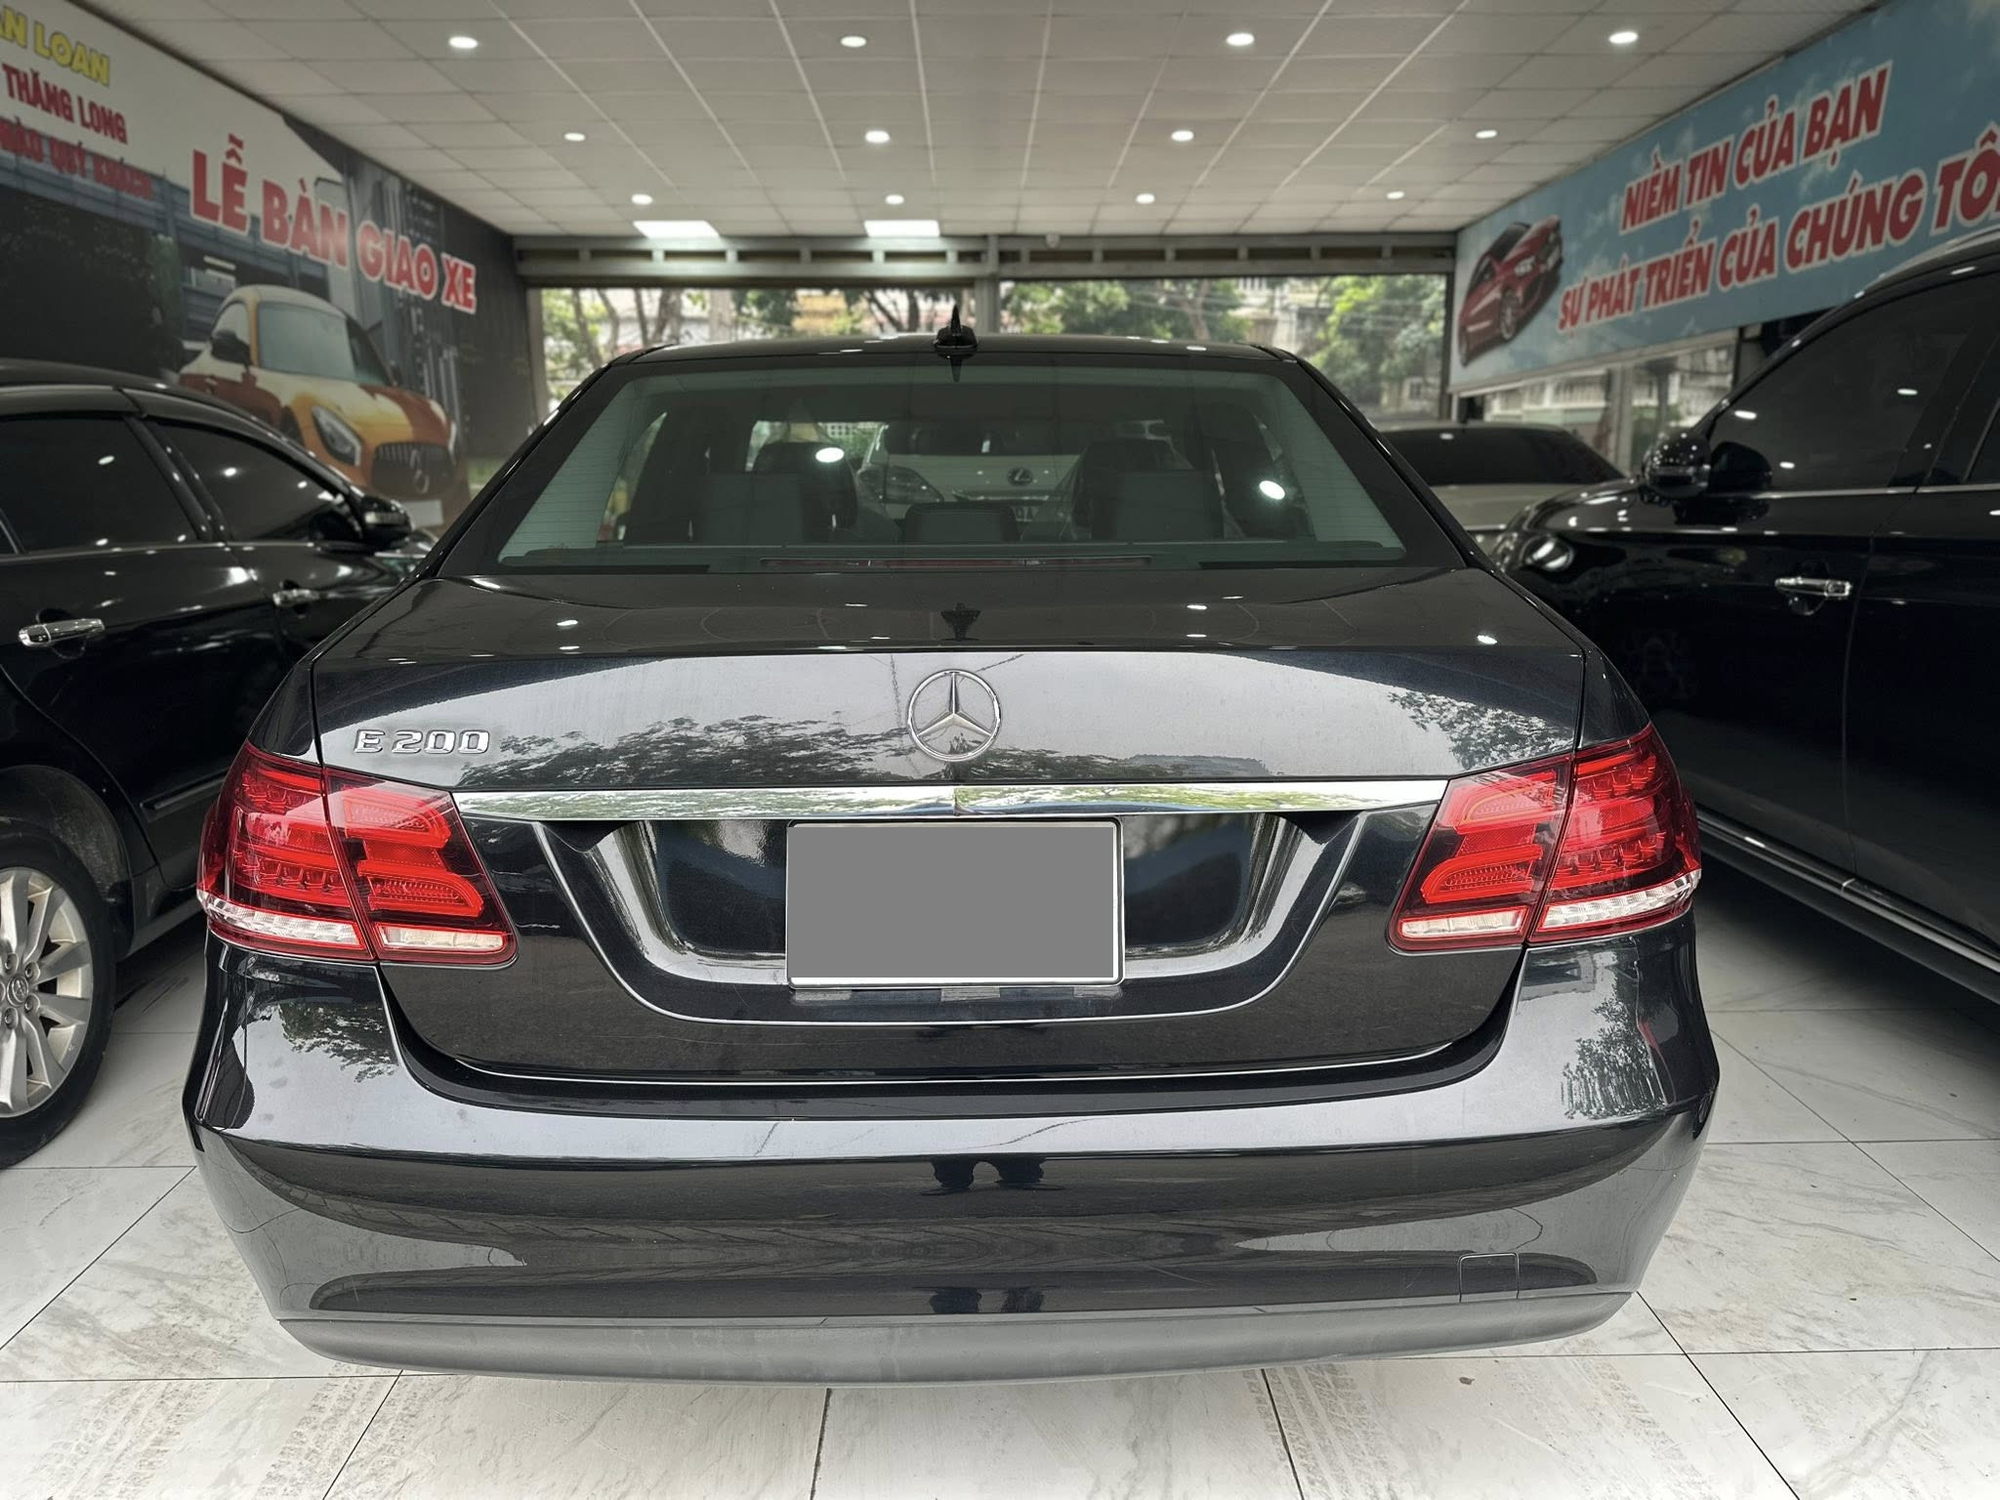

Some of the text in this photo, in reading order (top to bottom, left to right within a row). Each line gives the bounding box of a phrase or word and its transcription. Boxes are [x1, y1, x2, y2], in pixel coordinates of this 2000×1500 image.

[34, 20, 110, 87] LOAN
[77, 95, 128, 145] LONG
[1620, 63, 1892, 235] NIỀM TIN CỦA BẠN
[190, 132, 477, 315] LỄ BÀN GIAO XE
[1585, 256, 1642, 325] PHÁT
[1642, 216, 1716, 311] TRIỂN
[1717, 206, 1778, 292] CỦA
[1785, 173, 1926, 273] CHÚNG
[1931, 122, 2000, 235] TÔ
[354, 729, 490, 754] E 200
